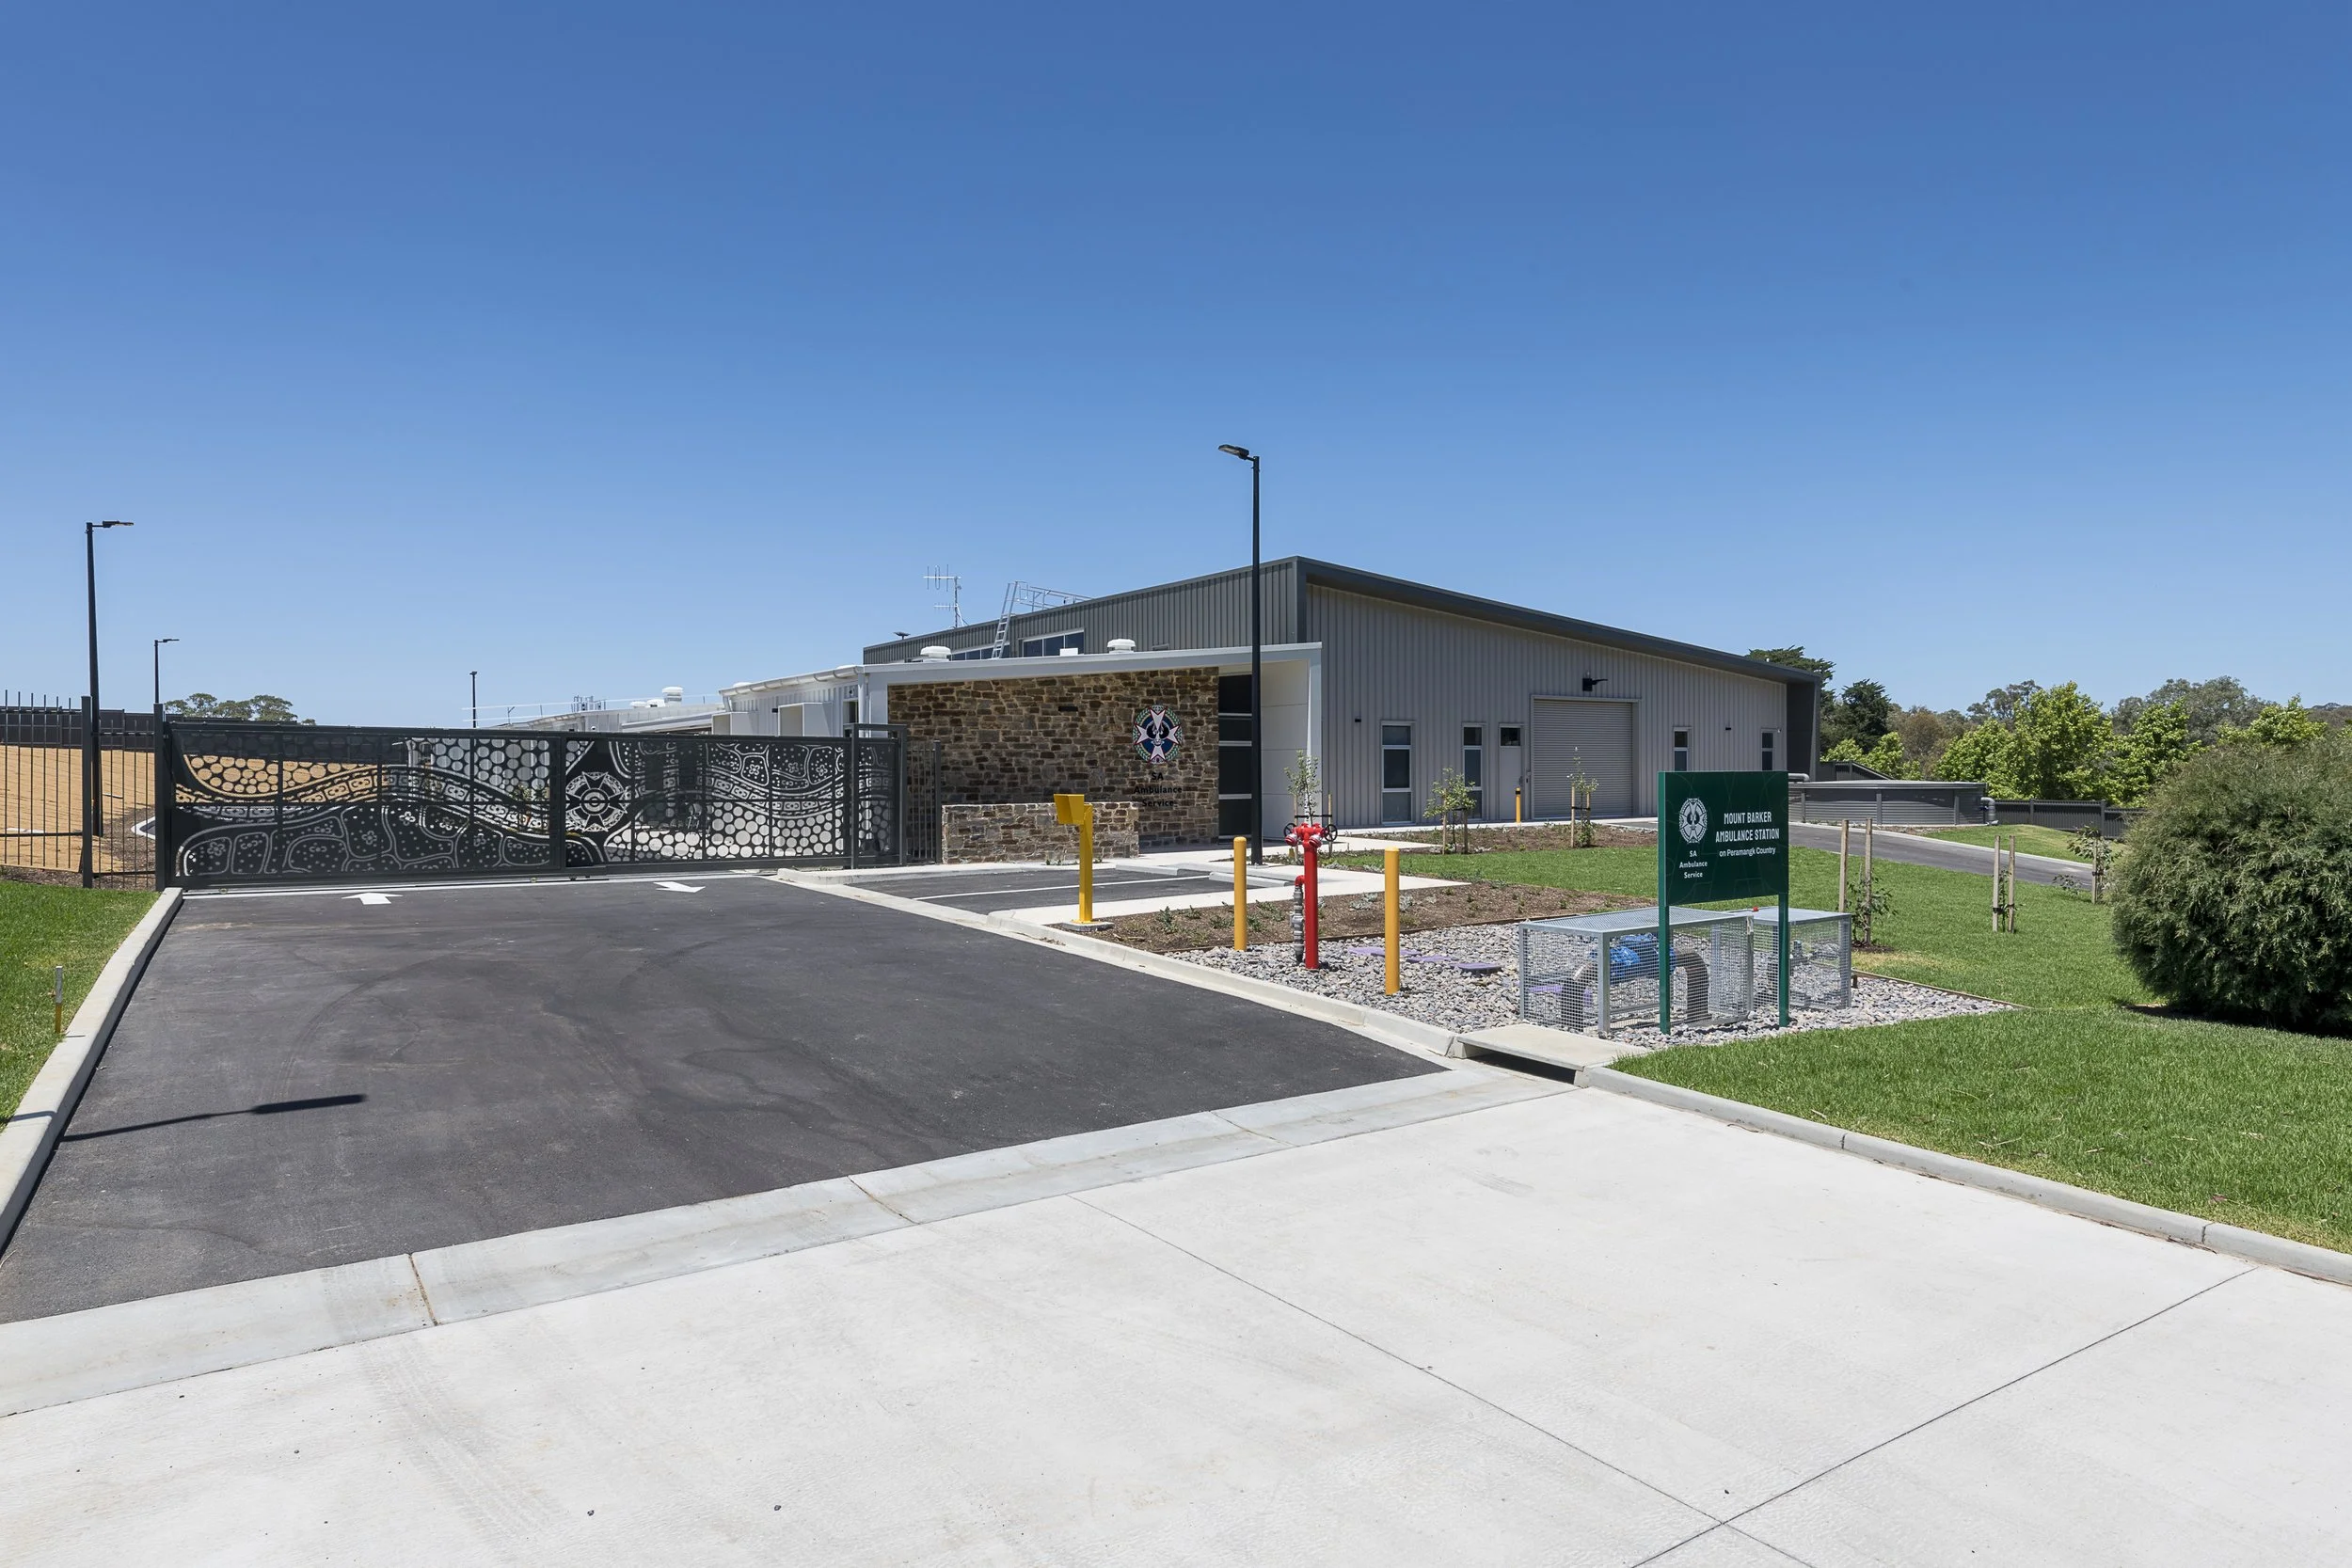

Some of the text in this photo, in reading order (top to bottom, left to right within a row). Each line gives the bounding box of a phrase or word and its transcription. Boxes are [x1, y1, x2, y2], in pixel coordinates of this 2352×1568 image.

[1152, 771, 1164, 780] SA
[1134, 785, 1183, 794] Ambulance
[1142, 799, 1174, 807] Service
[1724, 812, 1772, 825] MOUNT BARKER
[1715, 828, 1780, 843] AMBULANCE STATION
[1726, 847, 1756, 857] Peramangk
[1756, 847, 1776, 856] Country
